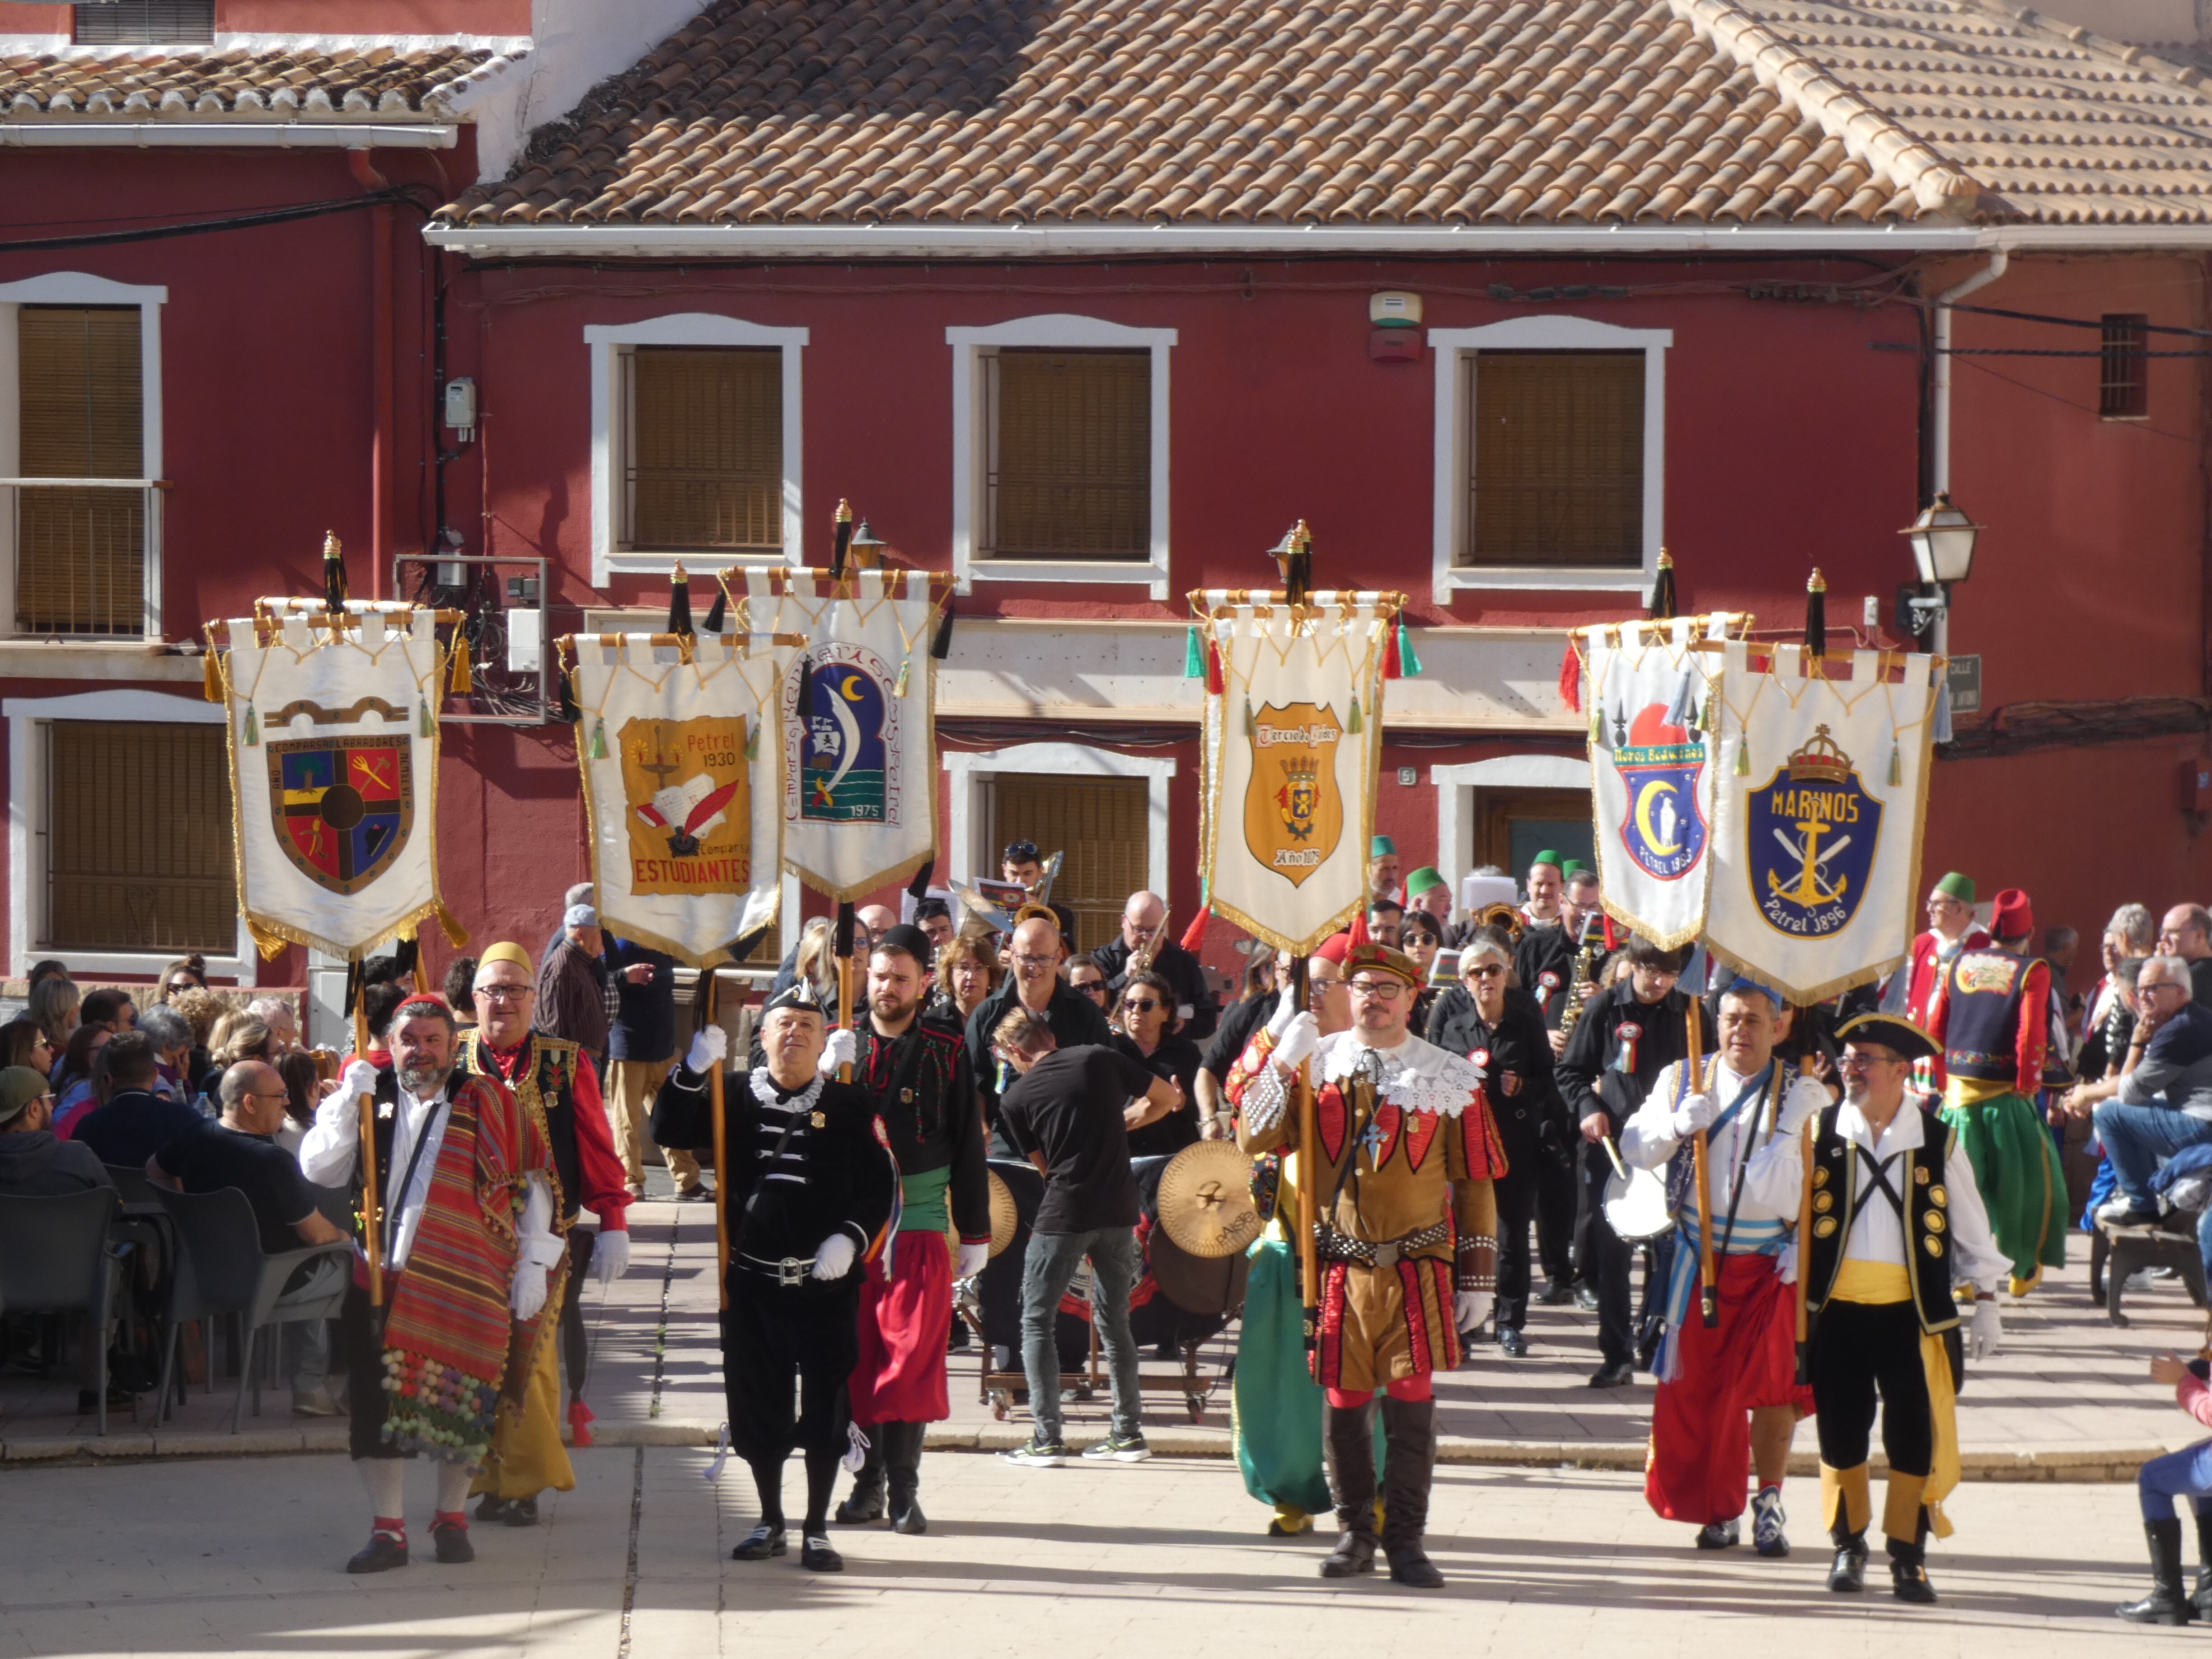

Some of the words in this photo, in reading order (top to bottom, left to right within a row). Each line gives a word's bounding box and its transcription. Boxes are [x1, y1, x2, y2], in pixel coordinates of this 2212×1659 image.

[275, 740, 329, 752] COMPARSA
[336, 736, 402, 748] LABRADORES
[688, 733, 735, 752] Petrel
[703, 752, 736, 767] 1930
[1614, 749, 1645, 762] Moros
[850, 805, 879, 817] 1975
[636, 859, 749, 883] ESTUDIANTES
[1764, 899, 1807, 932] Petrel
[1813, 906, 1846, 933] 1896
